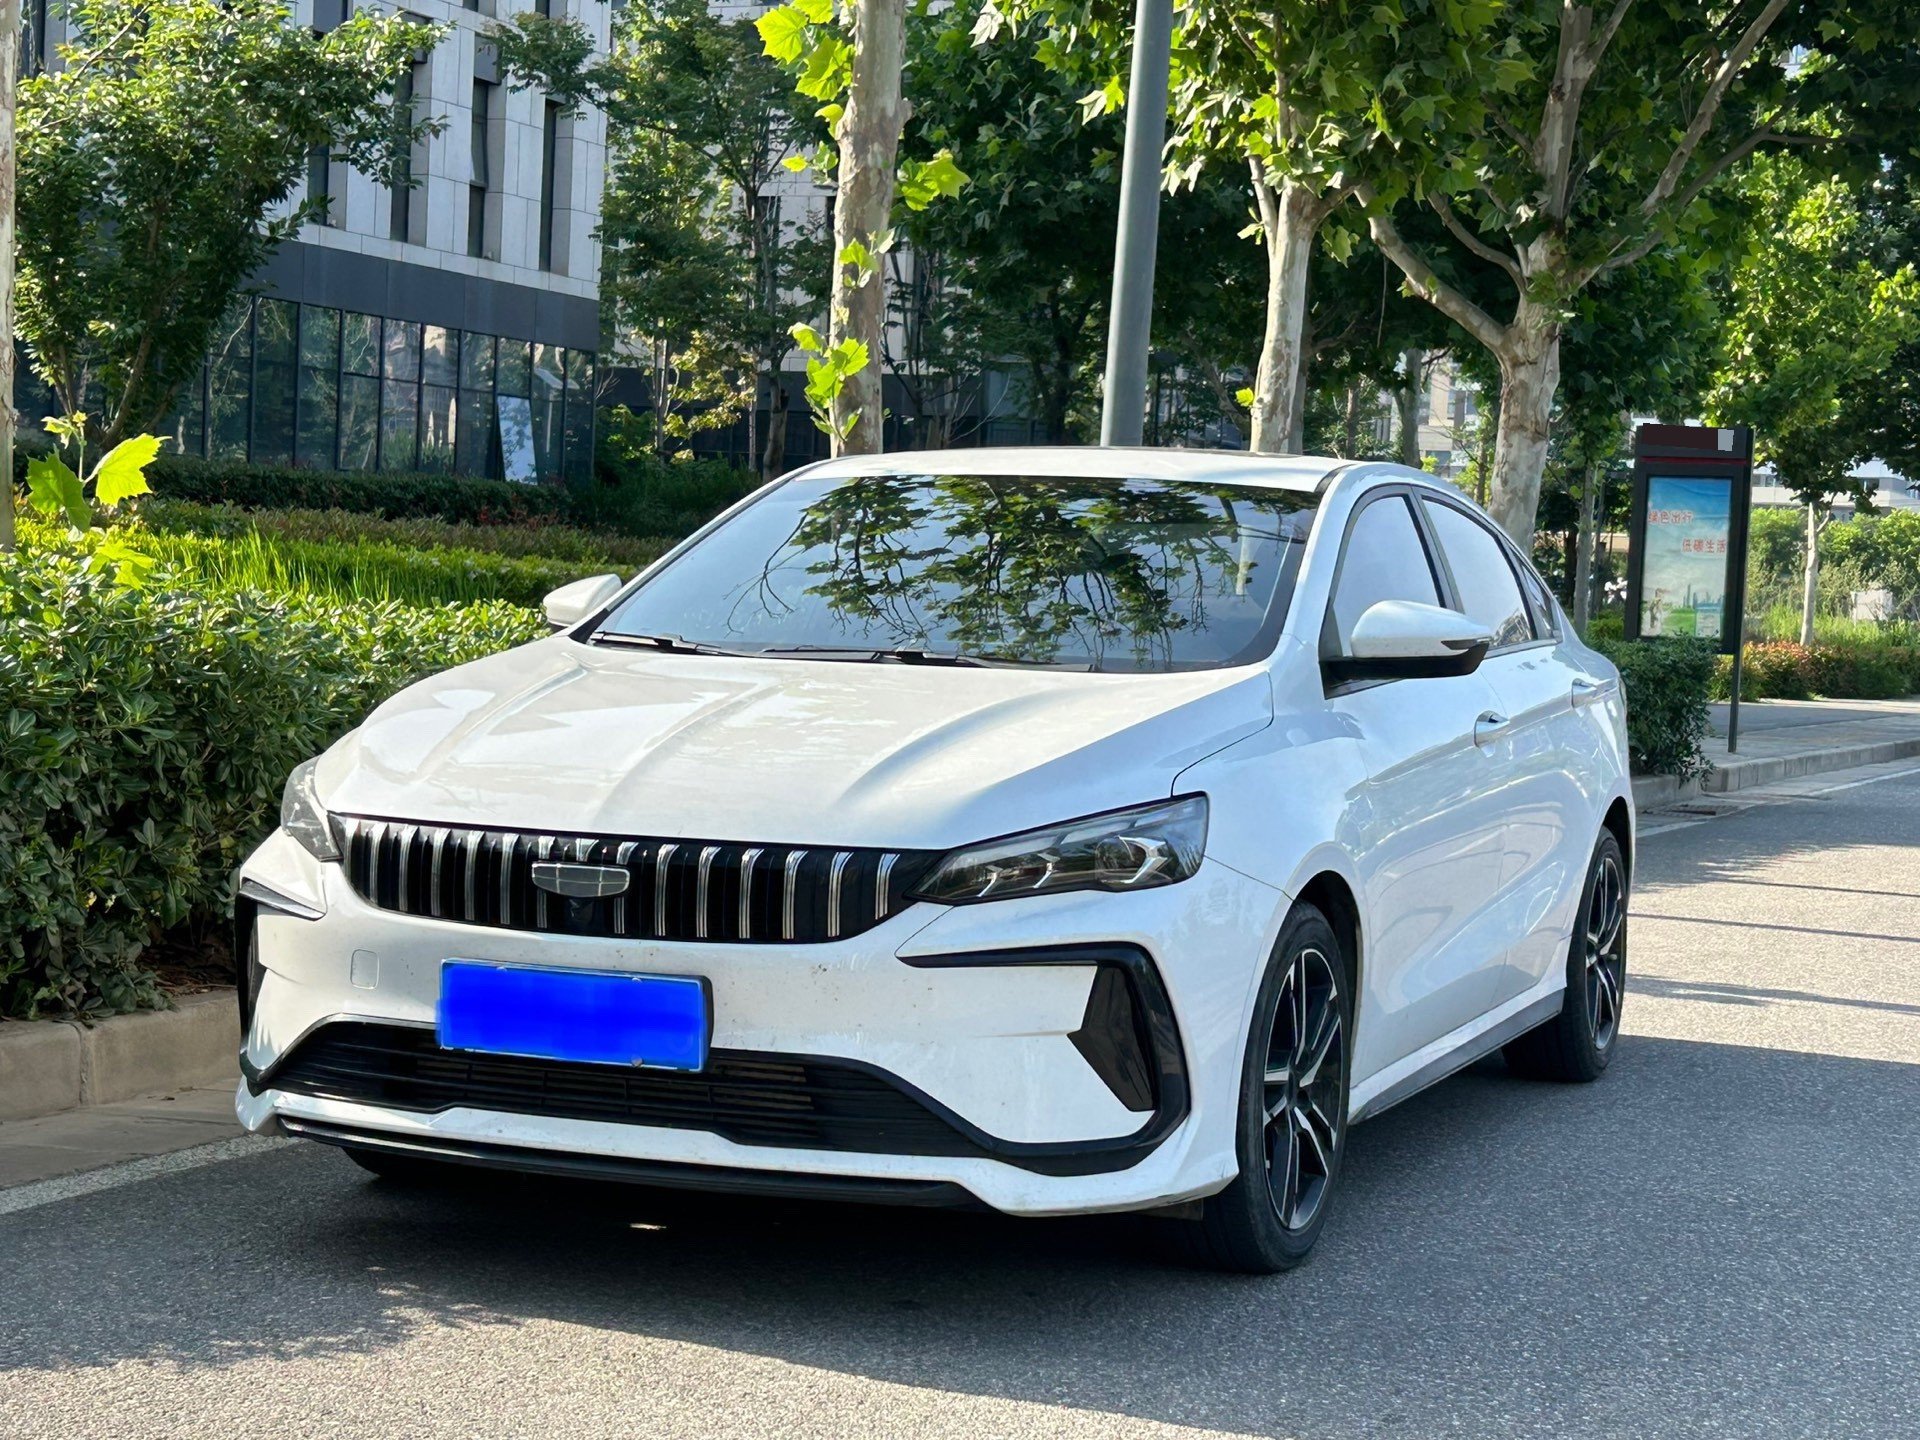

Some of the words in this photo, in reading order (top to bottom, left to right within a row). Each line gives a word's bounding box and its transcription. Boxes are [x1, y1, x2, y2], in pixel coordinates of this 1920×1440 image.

[1648, 510, 1693, 524] 绿色出行
[1682, 538, 1727, 553] 低碳生活
